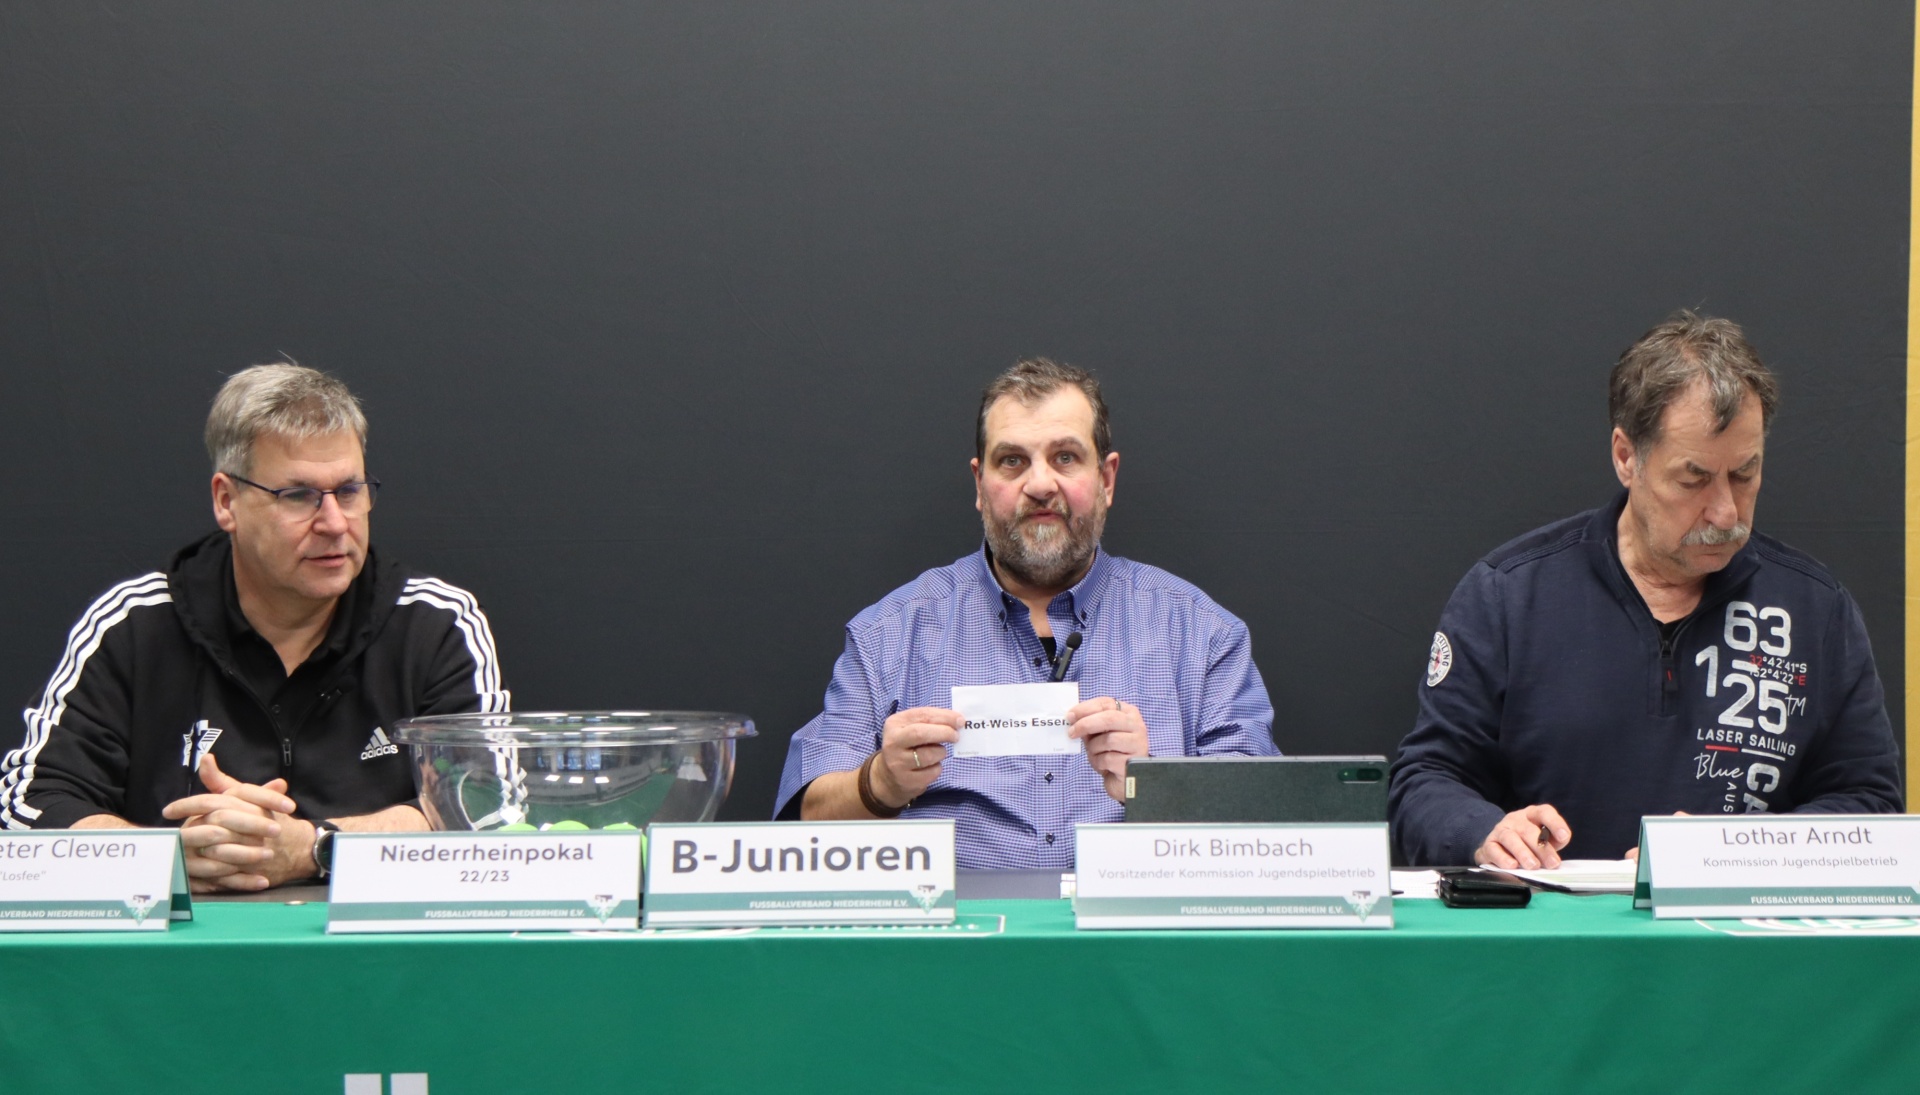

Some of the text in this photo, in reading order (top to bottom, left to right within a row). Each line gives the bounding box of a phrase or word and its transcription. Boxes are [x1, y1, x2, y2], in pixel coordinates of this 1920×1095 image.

[1724, 600, 1791, 657] 63
[964, 719, 1027, 730] Rot-Weiss
[1697, 728, 1796, 756] LASER SAILING
[361, 744, 399, 760] adidas
[1694, 751, 1744, 780] Blue
[1722, 826, 1873, 846] Lothar Arndt
[51, 838, 137, 858] Cleven
[380, 843, 594, 865] Niederrheinpokal
[1154, 838, 1314, 857] Dirk Bimbach
[672, 837, 931, 874] B-Junioren
[1703, 856, 1898, 869] Kommission Jugendspielbetrieb
[459, 869, 510, 884] 22/23
[1098, 867, 1376, 881] Vorsitzender Kommission Jugendspielbetrieb
[750, 900, 909, 909] FUSSBALLVERBAND NIEDERRHEIN E.V.
[1751, 896, 1913, 904] FUSSBALLVERBAND NIEDERRHEIN E.V.
[47, 910, 105, 918] NIEDERRHEIN
[106, 909, 122, 918] E.V.
[425, 909, 585, 918] FUSSBALLVERBAND NIEDERRHEIN E.V.
[1181, 906, 1344, 914] FUSSBALLVERBAND NIEDERRHEIN E.V.
